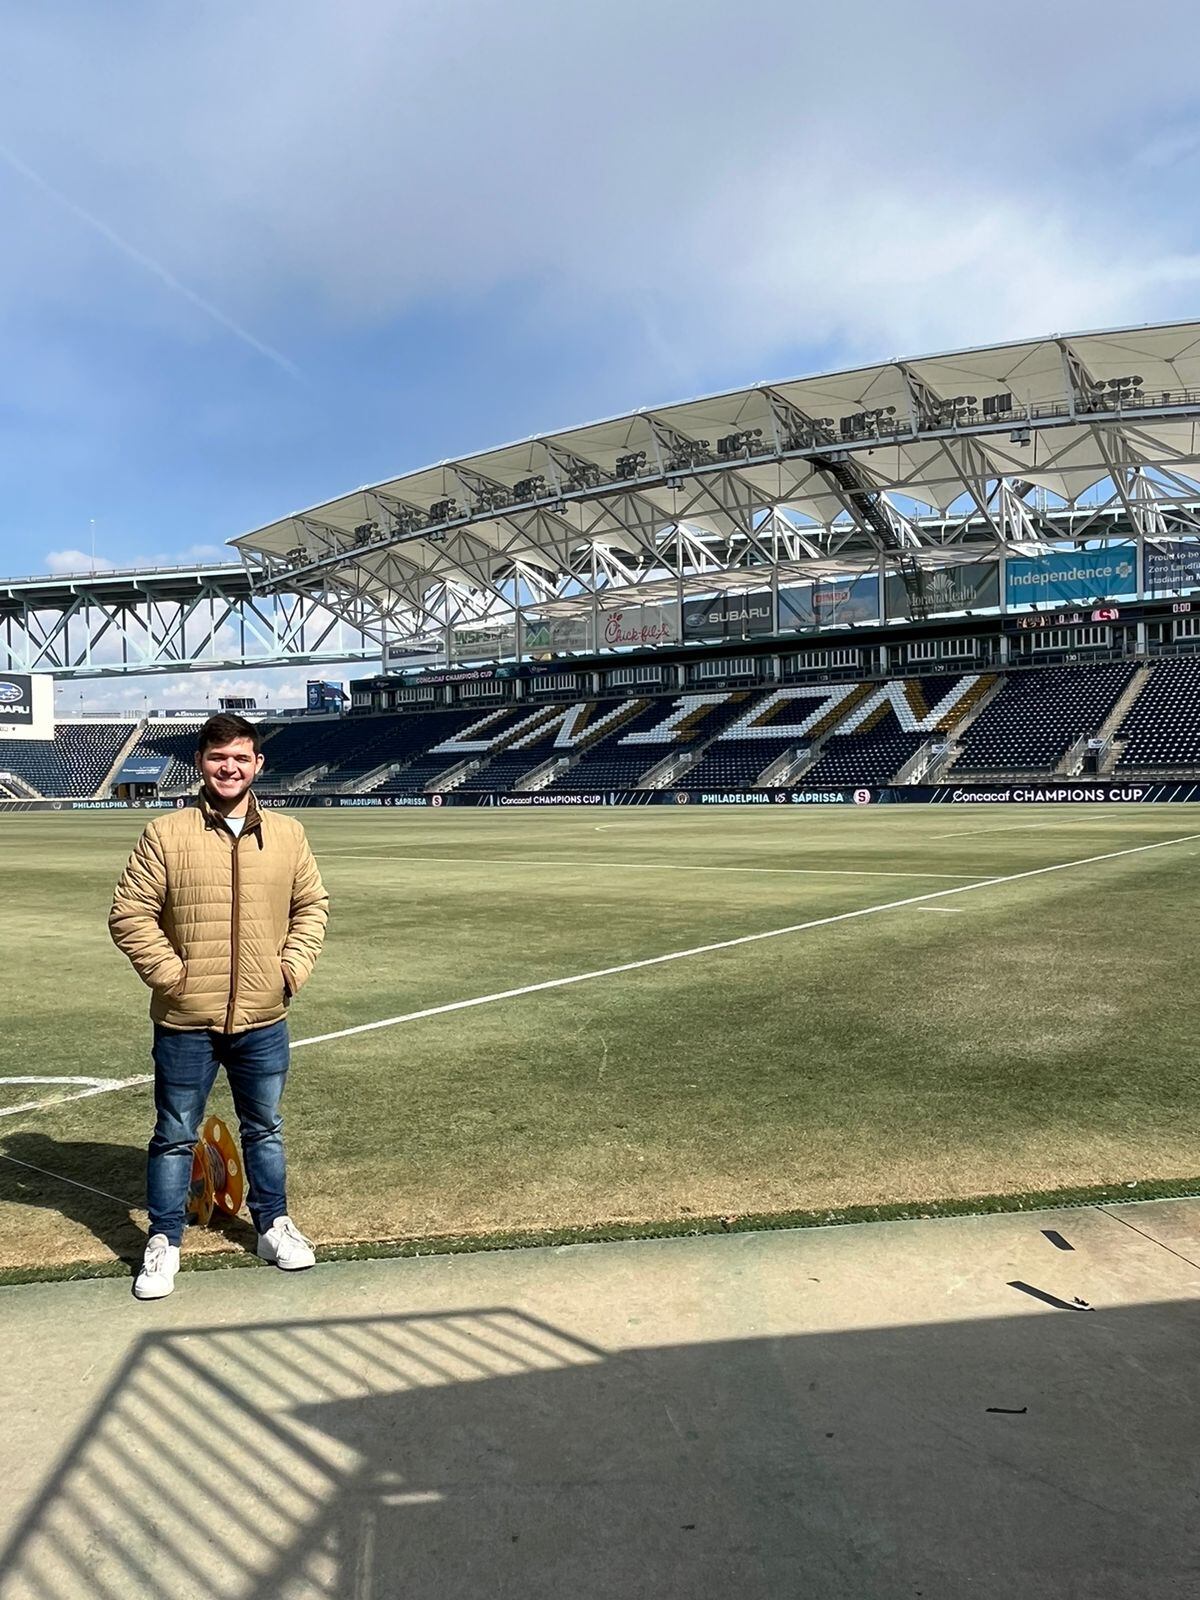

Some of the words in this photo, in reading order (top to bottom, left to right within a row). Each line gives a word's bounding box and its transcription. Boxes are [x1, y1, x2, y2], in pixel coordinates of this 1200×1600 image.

[1148, 553, 1175, 562] Proud
[1009, 566, 1112, 586] Independence
[1148, 576, 1184, 584] stadium
[1172, 603, 1191, 613] 0:00
[708, 606, 770, 623] SUBARU
[428, 674, 997, 754] UNION
[533, 796, 582, 804] CHAMPIONS
[583, 795, 601, 803] CUP
[701, 794, 770, 803] PHILADELPHIA
[791, 793, 844, 803] SAPRISSA
[952, 789, 1011, 802] Concacaf
[1013, 789, 1105, 802] CHAMPIONS
[1109, 789, 1143, 801] CUP
[72, 801, 128, 809] PHILADELPHIA
[272, 799, 286, 807] CUP
[340, 798, 382, 806] PHILADELPHIA
[394, 797, 427, 806] SAPRISSA
